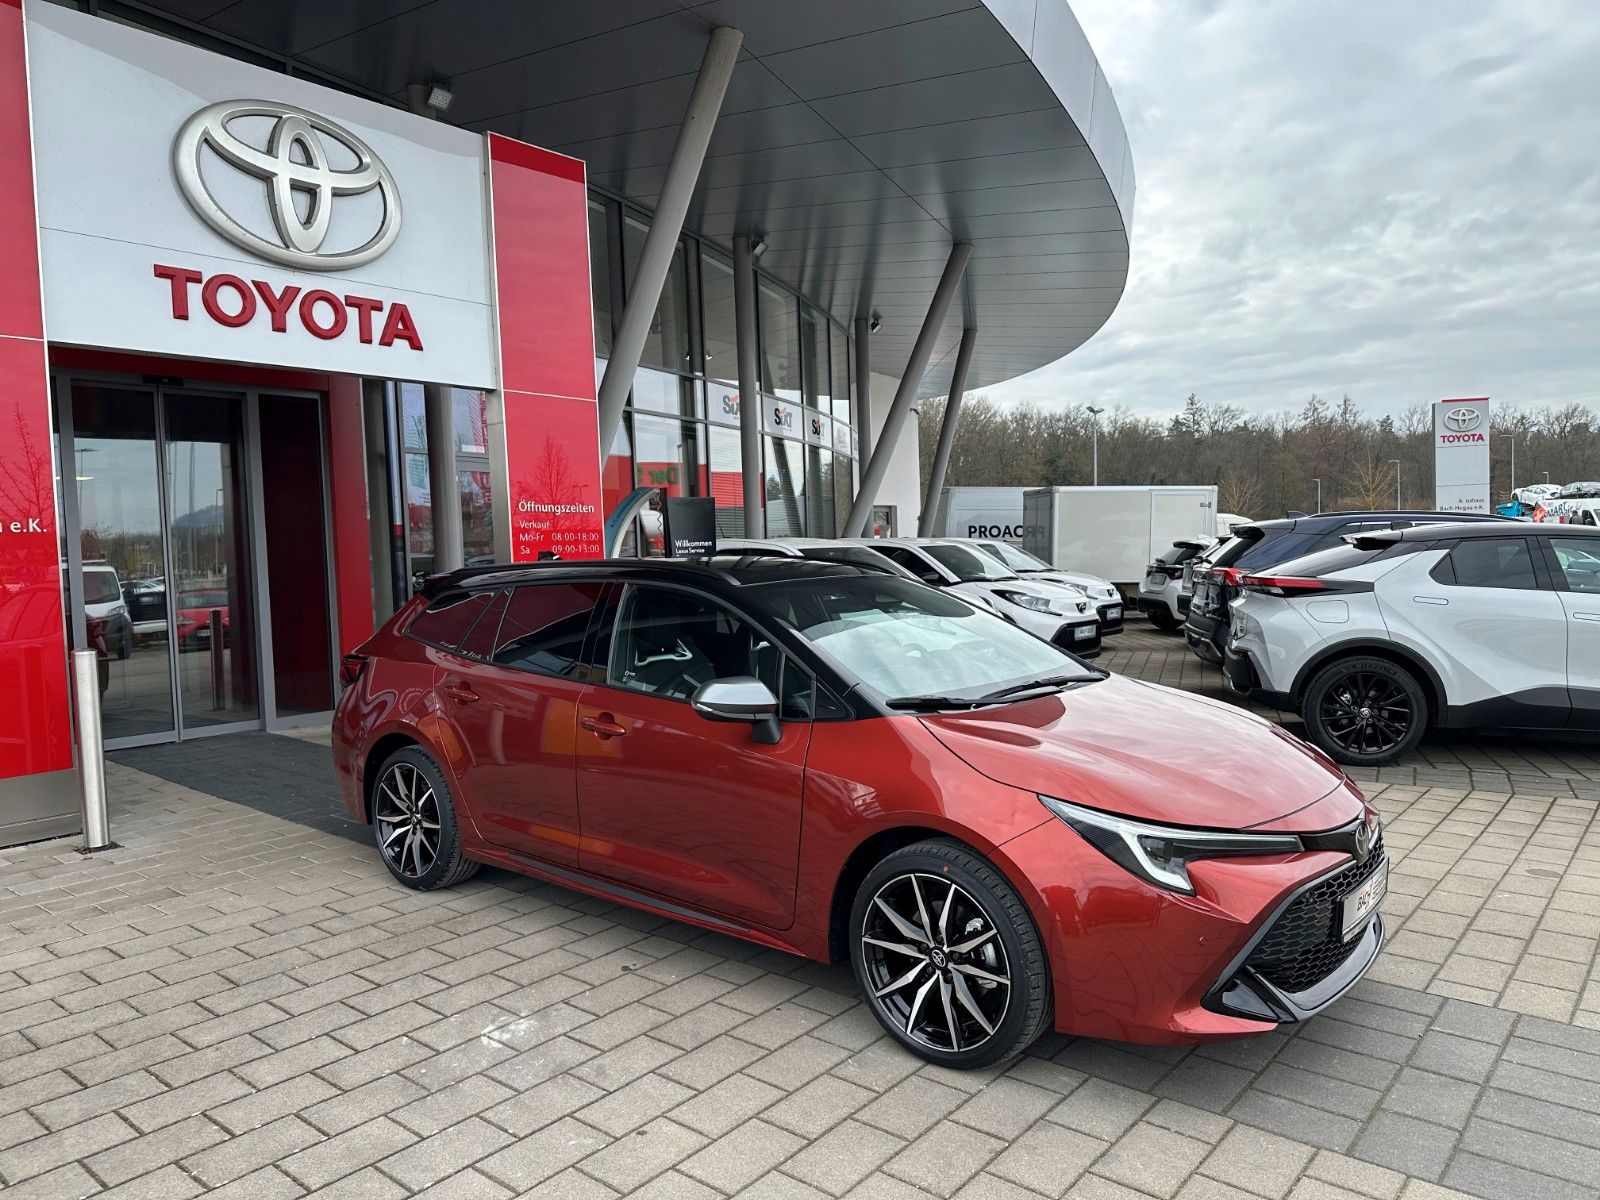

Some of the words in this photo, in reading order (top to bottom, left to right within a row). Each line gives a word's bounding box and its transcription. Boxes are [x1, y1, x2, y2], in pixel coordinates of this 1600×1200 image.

[154, 264, 423, 351] TOYOTA
[1440, 433, 1484, 443] TOYOTA
[518, 499, 595, 516] Öffnungszeiten
[10, 518, 48, 533] e.K.
[519, 520, 550, 529] Verkauf
[519, 533, 544, 542] Mo-Fr
[551, 532, 599, 541] 08:00-18:00
[968, 525, 1023, 538] PROAC
[520, 545, 530, 555] Sa
[552, 544, 600, 554] 09:00-13:00
[675, 540, 713, 548] Willkommen
